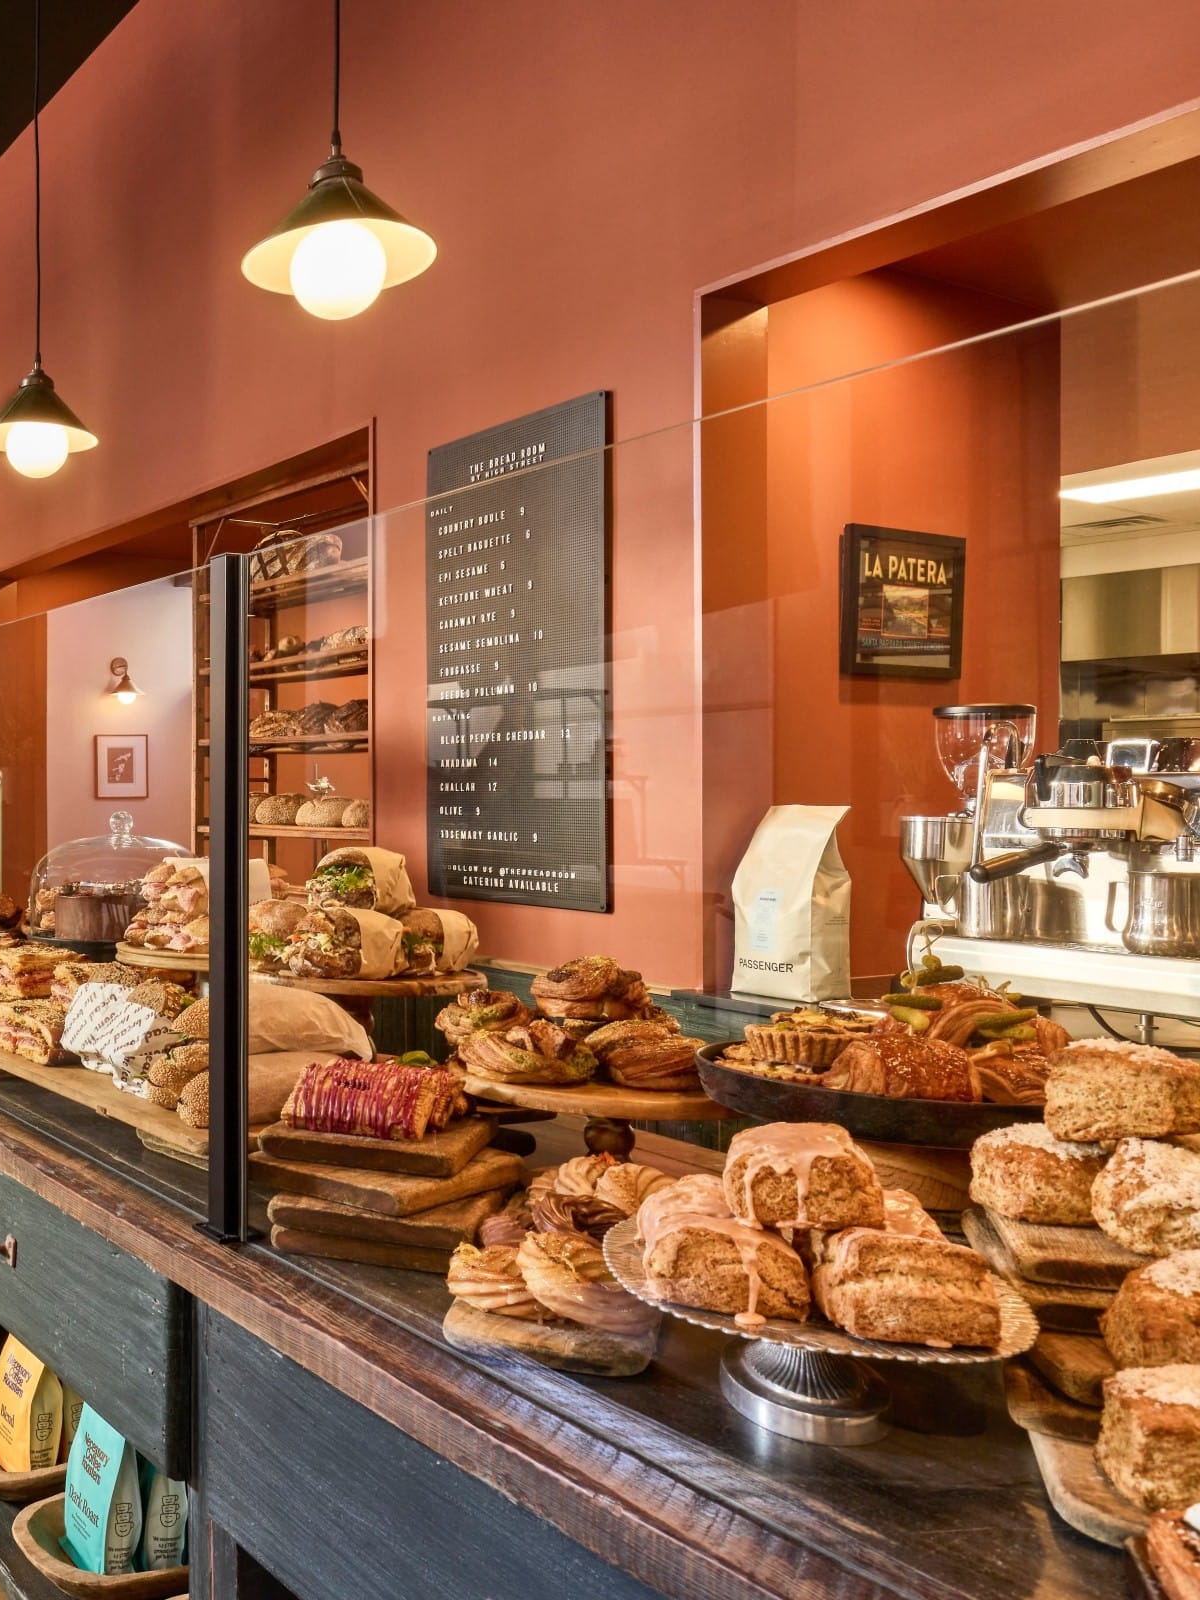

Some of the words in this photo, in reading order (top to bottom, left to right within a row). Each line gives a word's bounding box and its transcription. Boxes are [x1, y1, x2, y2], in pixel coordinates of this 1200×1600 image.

[470, 462, 484, 475] THE
[489, 452, 516, 469] BREAD
[521, 443, 546, 458] ROOM
[471, 474, 481, 482] BY
[485, 467, 505, 478] HIGH
[510, 455, 543, 470] STREET
[430, 506, 453, 517] DAILY
[438, 519, 474, 536] COUNTRY
[478, 510, 506, 526] BOULE
[520, 506, 525, 516] 9
[438, 545, 463, 559] SPELT
[467, 533, 511, 552] BAGUETTE
[439, 572, 452, 583] EPI
[455, 563, 489, 580] SESAME
[864, 552, 883, 578] LA
[888, 555, 947, 585] PATERA
[439, 590, 480, 607] KEYSTONE
[484, 583, 513, 598] WHEAT
[439, 615, 476, 630] CARAWAY
[481, 611, 496, 623] RYE
[439, 640, 472, 654] SESAME
[475, 633, 520, 649] SEMOLINA
[534, 630, 543, 640] 10
[440, 663, 480, 678] FOUGASSE
[440, 735, 465, 745] BLACK
[469, 732, 501, 743] PEPPER
[506, 729, 546, 742] CHEDDAR
[440, 758, 478, 768] ANADAMA
[488, 757, 498, 767] 14
[440, 782, 476, 792] CHALLAH
[488, 782, 498, 792] 12
[440, 806, 463, 816] OLIVE
[487, 831, 519, 842] GARLIC
[482, 866, 493, 874] US
[463, 875, 504, 888] CATERING
[508, 879, 559, 893] AVAILABLE
[739, 958, 794, 973] PASSENGER
[85, 1448, 101, 1472] Coffee
[69, 1483, 84, 1511] Dark
[82, 1499, 99, 1529] Roast
